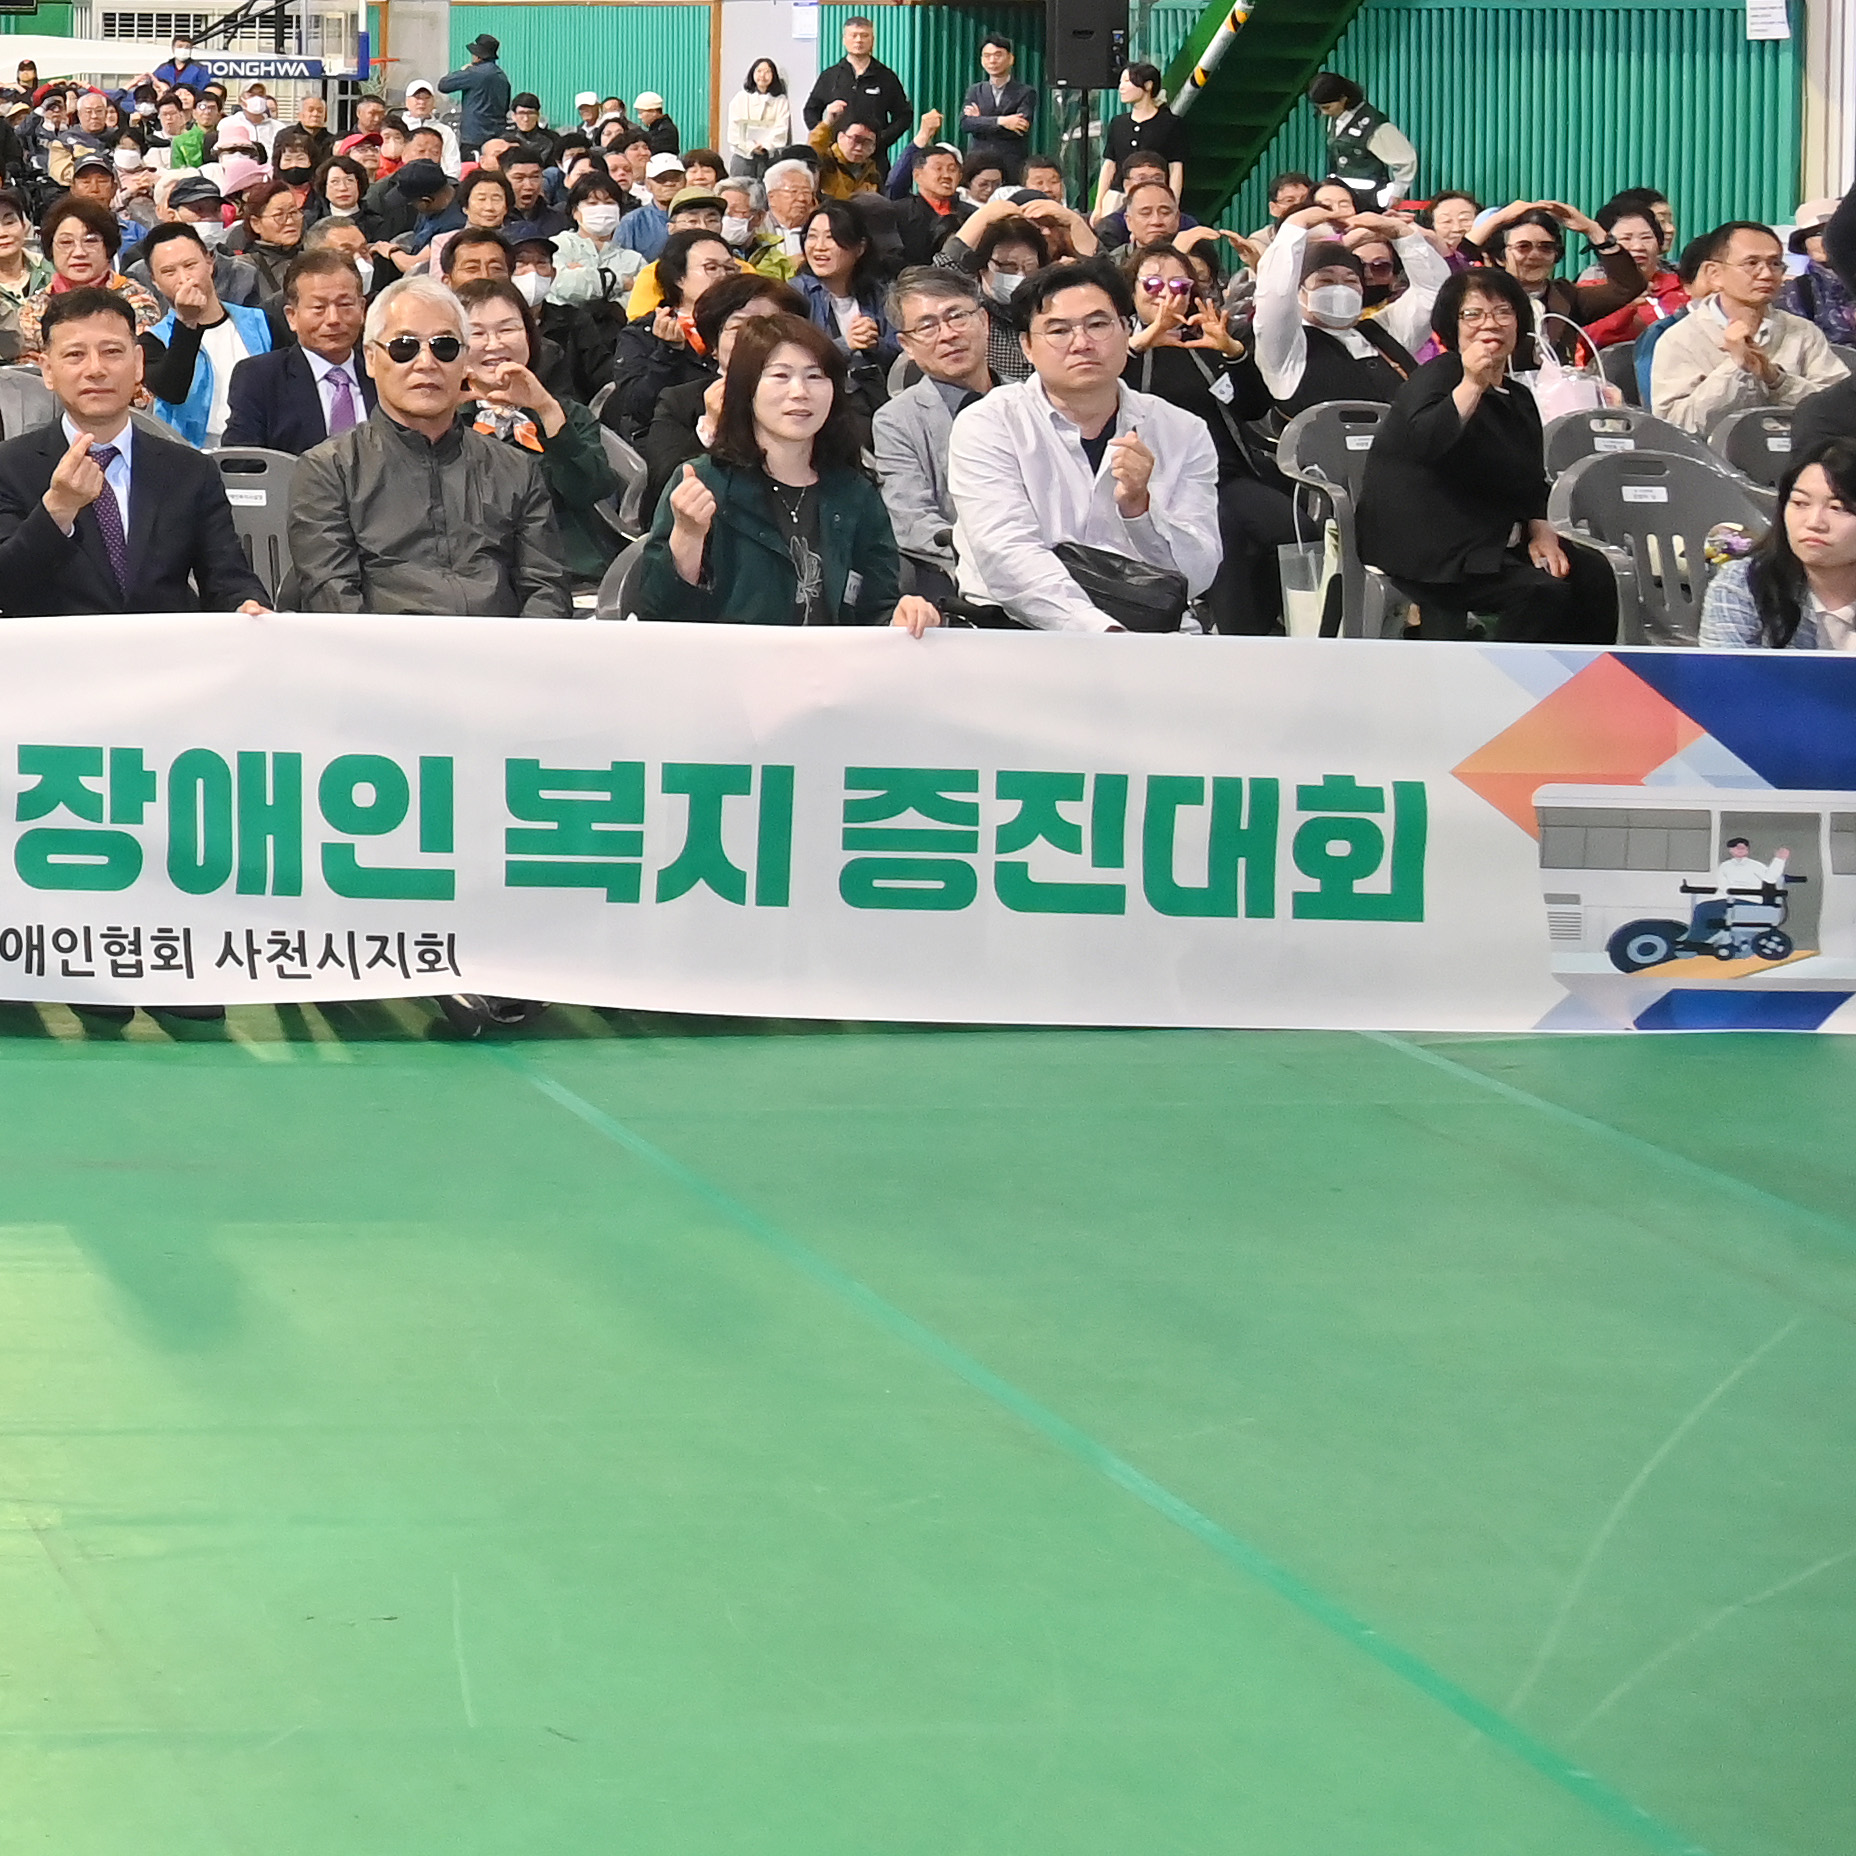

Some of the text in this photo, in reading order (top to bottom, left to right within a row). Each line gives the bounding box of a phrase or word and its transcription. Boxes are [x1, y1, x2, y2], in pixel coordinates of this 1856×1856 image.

[503, 758, 795, 907] 복지
[838, 766, 1428, 924] 증진대회
[215, 929, 462, 982] 사천시지회
